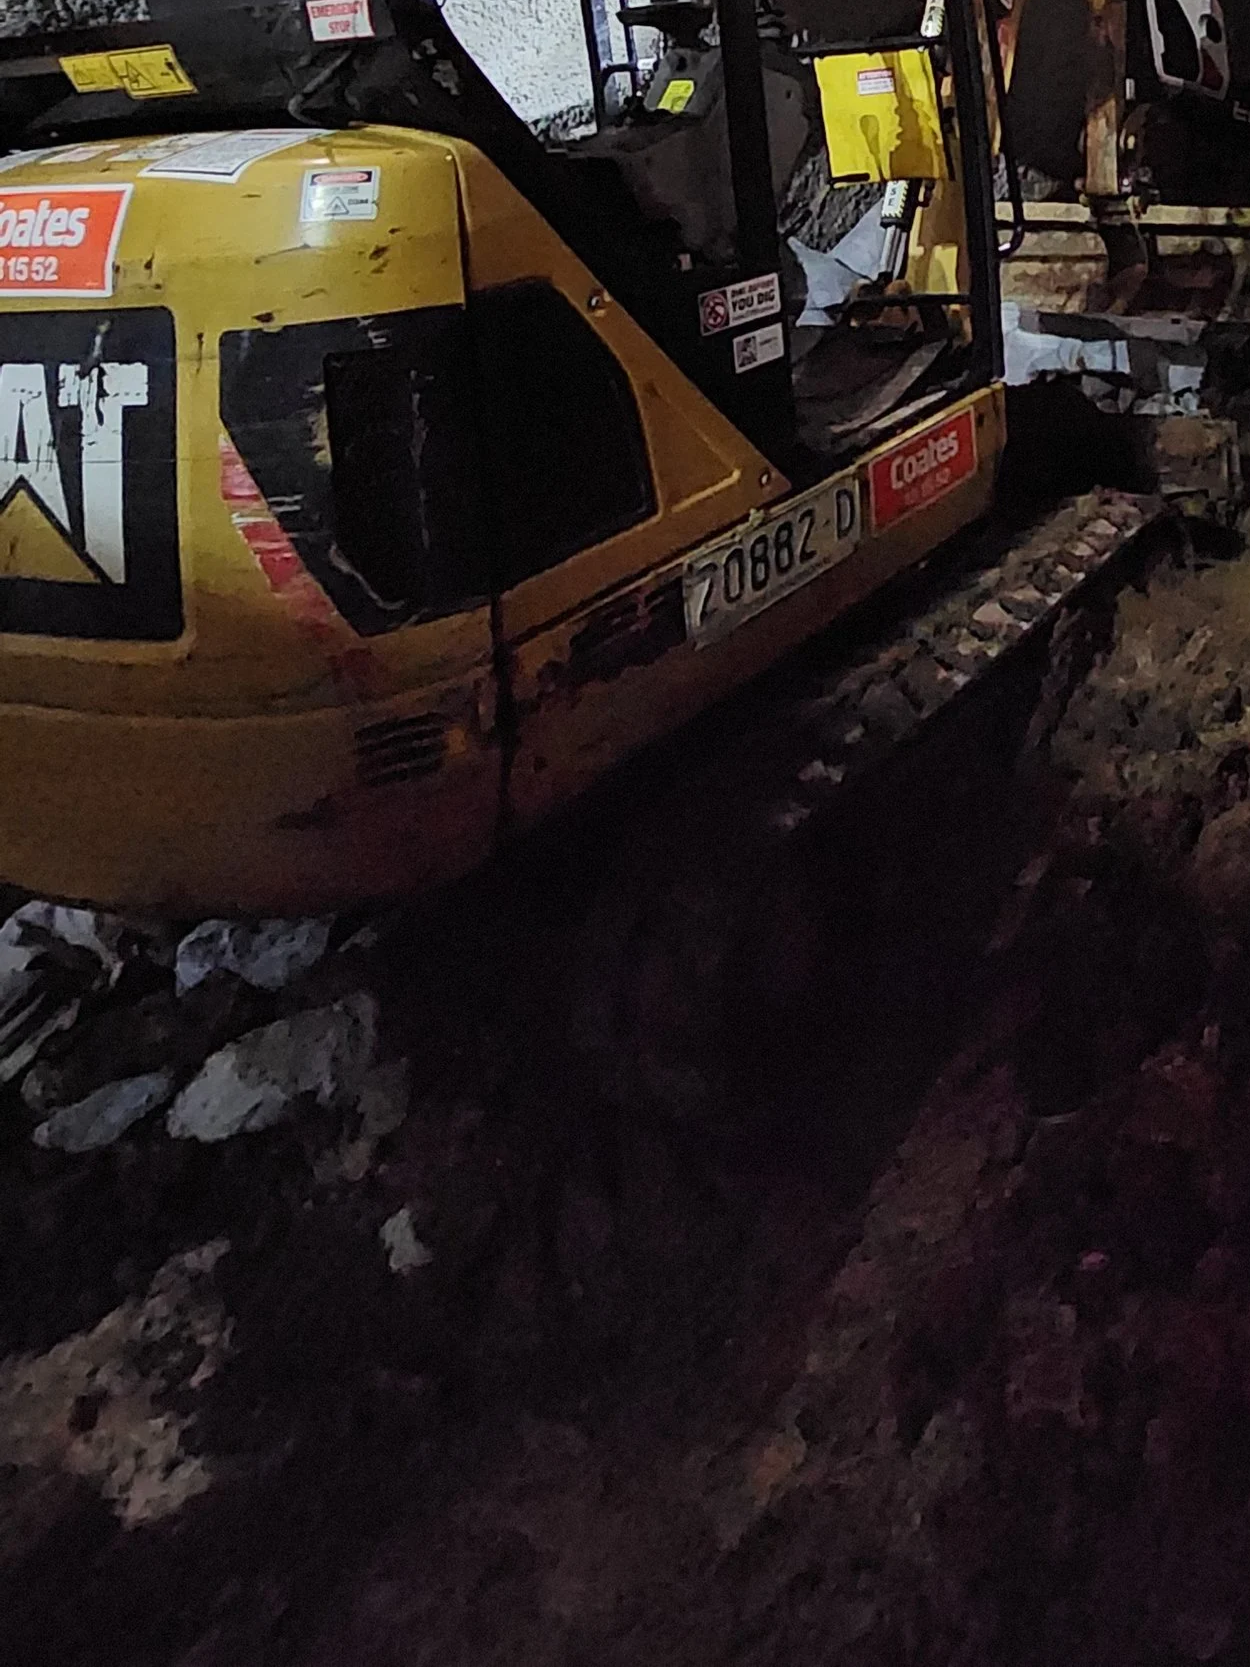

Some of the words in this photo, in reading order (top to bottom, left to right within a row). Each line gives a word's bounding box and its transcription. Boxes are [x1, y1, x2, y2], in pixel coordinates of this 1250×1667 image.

[328, 20, 351, 34] STOP
[0, 198, 91, 248] oates
[731, 295, 754, 313] YOU
[757, 289, 775, 305] DIG
[891, 430, 959, 491] Coates
